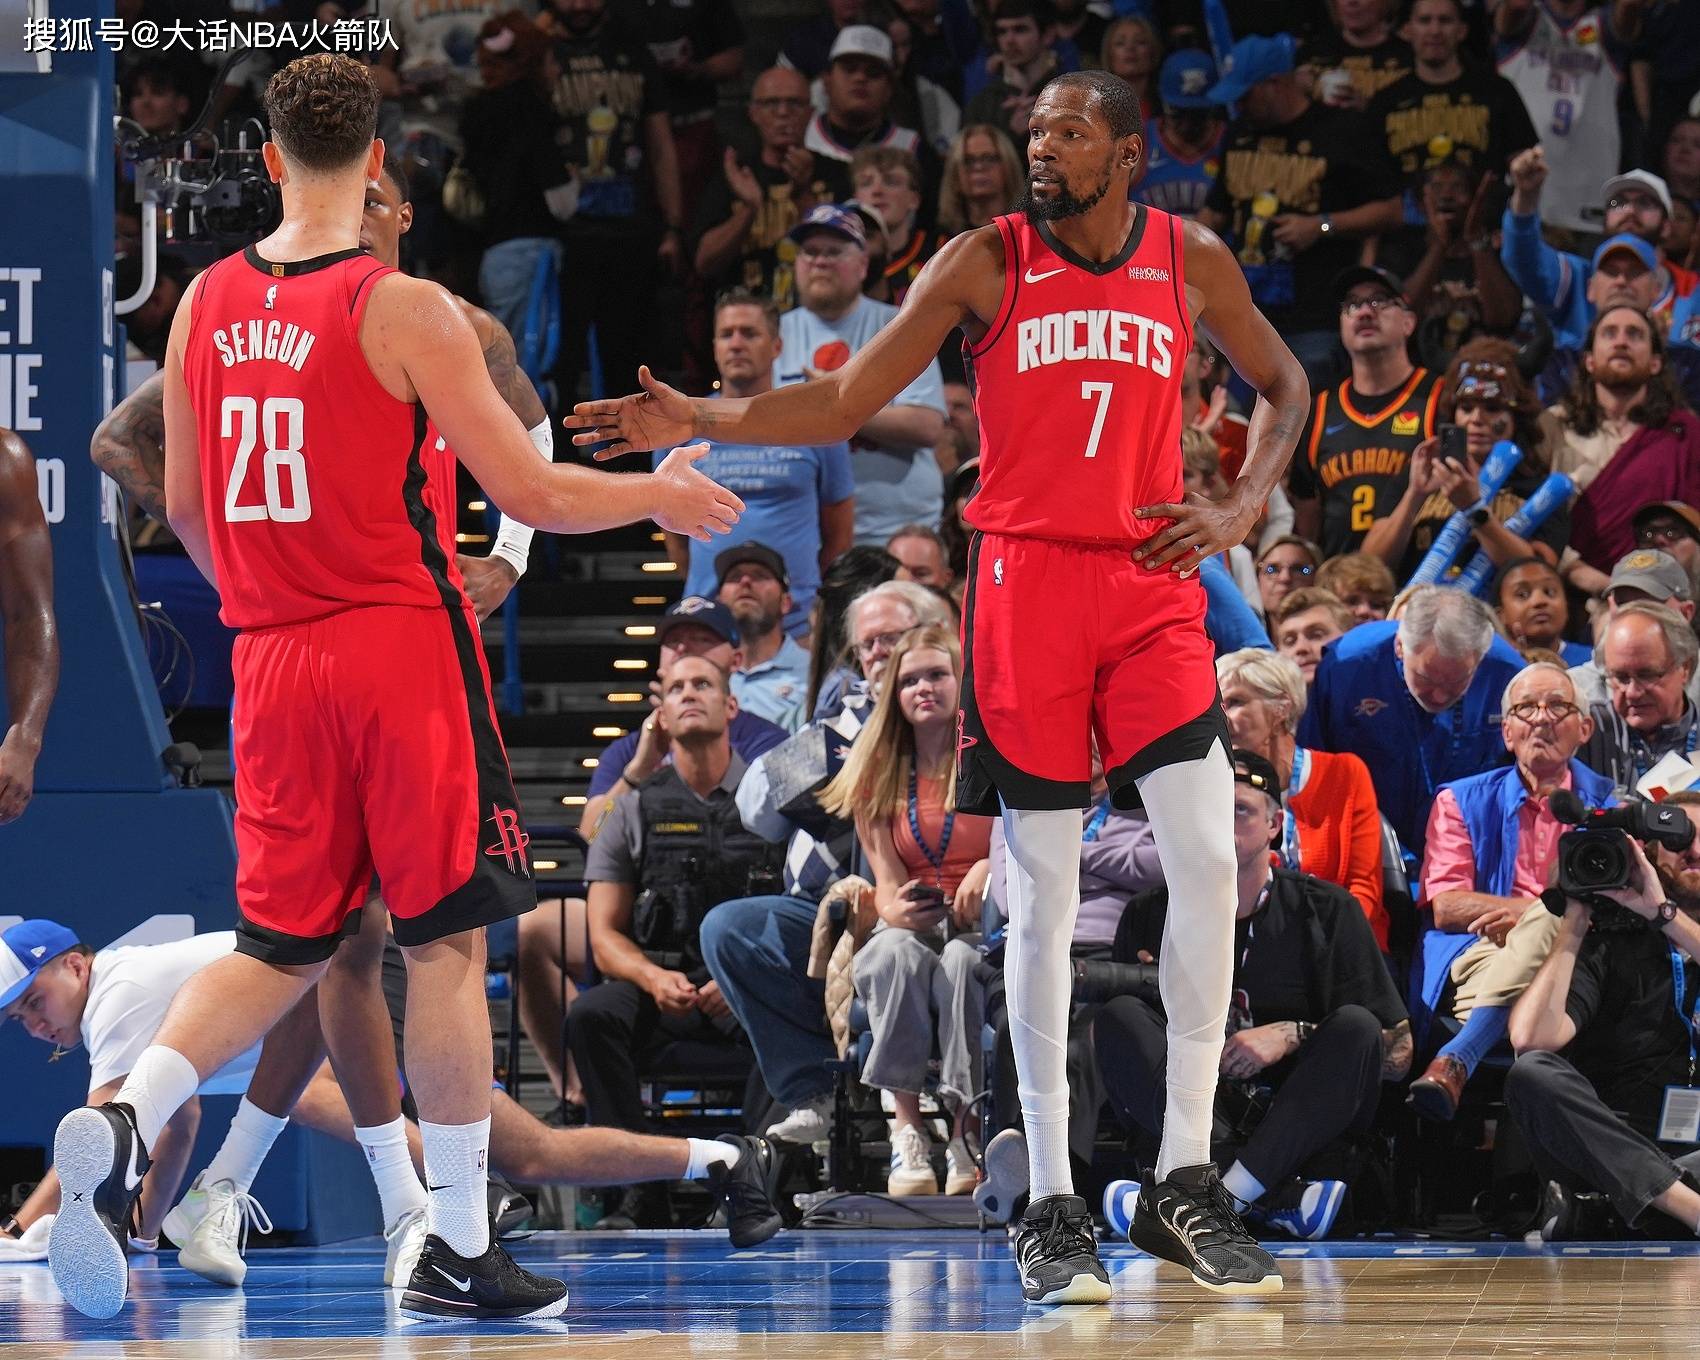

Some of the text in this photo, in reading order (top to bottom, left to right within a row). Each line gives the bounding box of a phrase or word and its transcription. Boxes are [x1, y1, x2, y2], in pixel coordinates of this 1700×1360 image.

[1128, 267, 1168, 276] MEMORIAL
[1129, 272, 1169, 281] HERMANN
[212, 319, 316, 372] SENGUN
[1017, 309, 1174, 379] ROCKETS
[1081, 381, 1114, 458] 7
[220, 396, 312, 523] 28
[1320, 447, 1406, 488] OKLAHOM
[1351, 484, 1376, 532] 2
